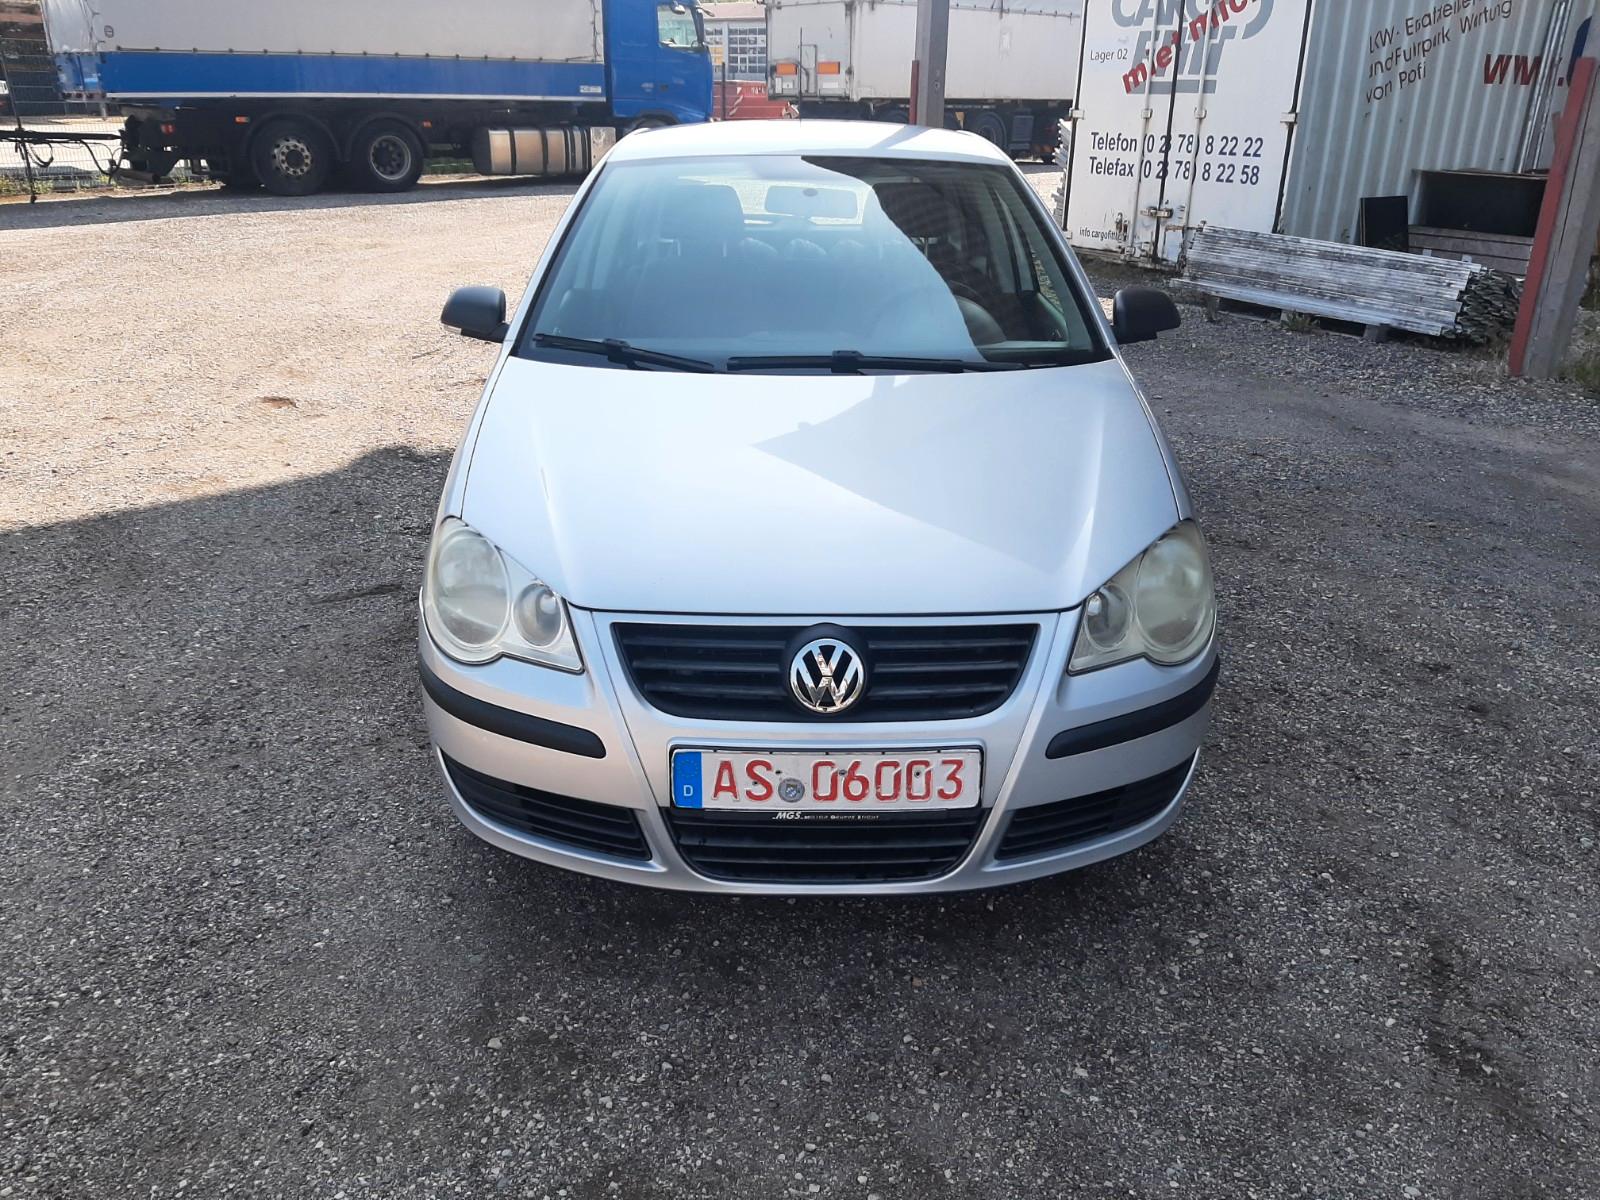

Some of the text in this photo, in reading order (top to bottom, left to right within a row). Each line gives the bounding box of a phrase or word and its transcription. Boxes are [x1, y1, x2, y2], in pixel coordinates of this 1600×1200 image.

[1090, 48, 1128, 62] Lager 02
[1090, 132, 1138, 152] Telefon
[1205, 135, 1214, 155] 8
[1218, 136, 1239, 156] 22
[1243, 137, 1264, 157] 22
[1089, 156, 1134, 177] Telefax
[1202, 162, 1211, 182] 8
[1216, 163, 1236, 183] 22
[1240, 165, 1260, 185] 58
[683, 759, 965, 801] D AS 06003
